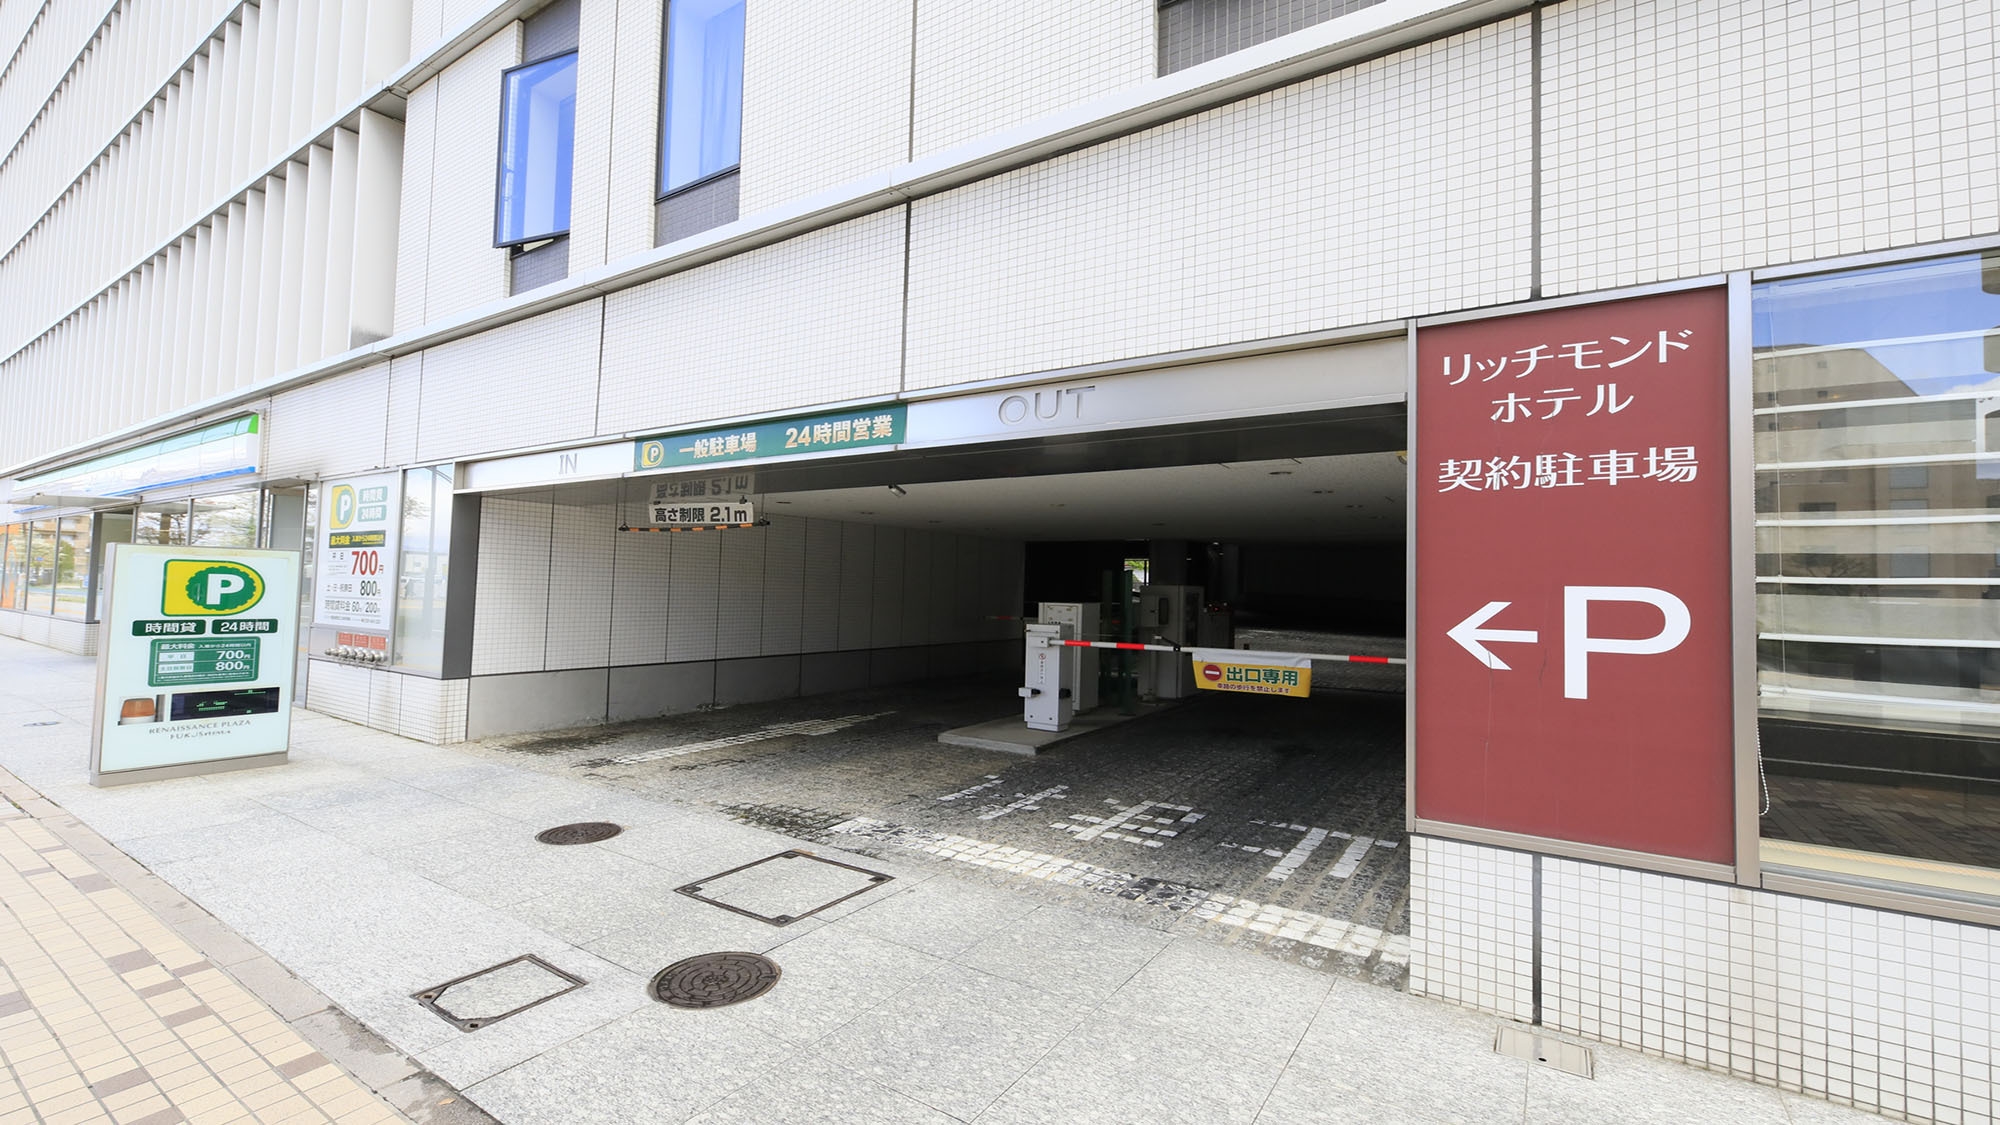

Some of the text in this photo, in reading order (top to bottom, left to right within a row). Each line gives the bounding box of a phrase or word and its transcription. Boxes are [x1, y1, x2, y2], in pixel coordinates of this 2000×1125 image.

[1443, 329, 1694, 386] リッチモンド
[998, 385, 1096, 426] OUT
[1490, 383, 1635, 423] ホテル
[679, 414, 893, 459] 一般駐車場 24時間営業
[558, 454, 578, 474] IN
[1437, 446, 1700, 493] 契約駐車場
[655, 505, 748, 523] 高さ制限 2.1m
[206, 574, 245, 605] P
[145, 622, 197, 634] 時間貸
[220, 621, 270, 632] 24時間
[1564, 585, 1691, 700] P
[1227, 667, 1298, 686] 出口専用
[148, 718, 252, 734] RENAISSANCE PLAZA
